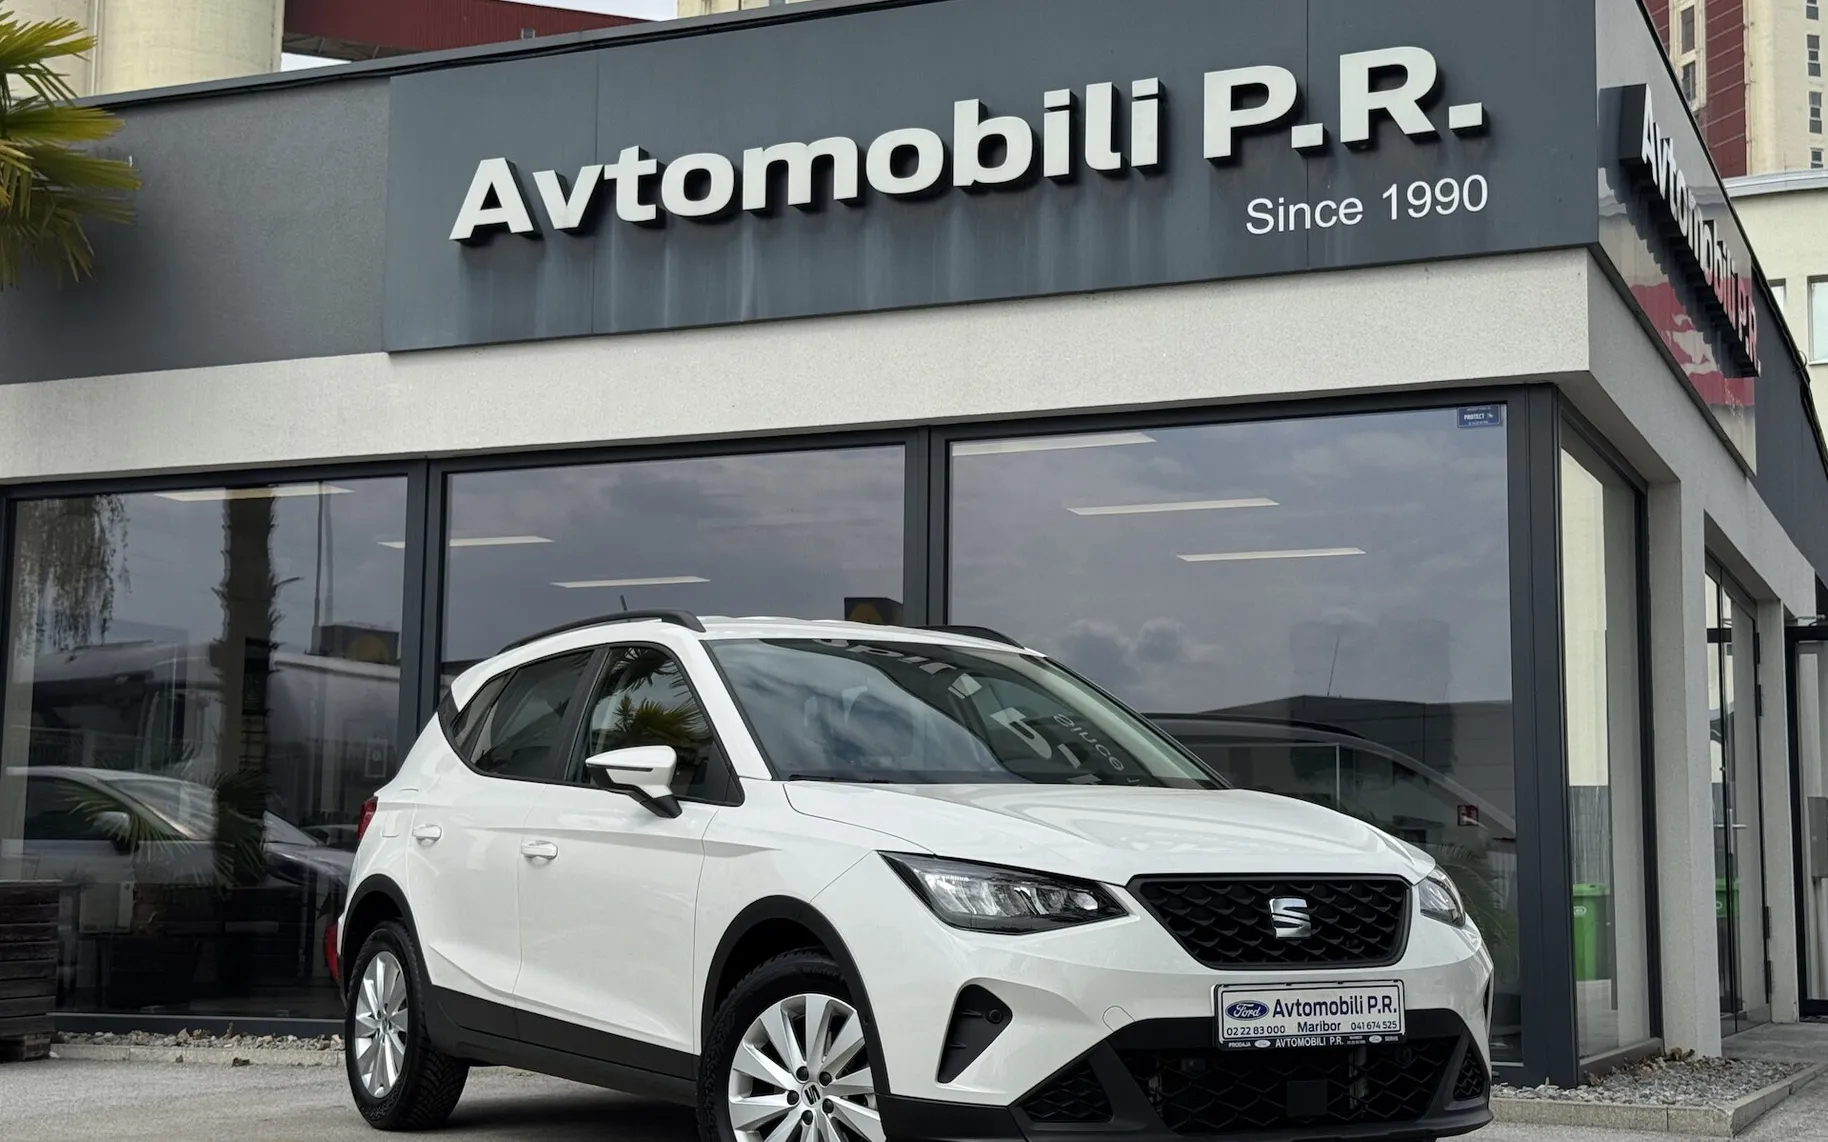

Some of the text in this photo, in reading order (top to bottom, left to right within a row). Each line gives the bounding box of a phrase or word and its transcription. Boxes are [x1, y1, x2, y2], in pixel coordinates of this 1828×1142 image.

[449, 46, 1484, 242] Avtomobili P.R.
[1246, 174, 1489, 235] Since 1990
[1272, 995, 1364, 1018] Avtomobili
[1367, 995, 1397, 1014] P.R.
[1226, 1020, 1397, 1036] 02 22 83 000 Maribor 041 674 525
[1275, 1036, 1326, 1048] AVTOMOBILI
[1329, 1036, 1344, 1046] P.R.
